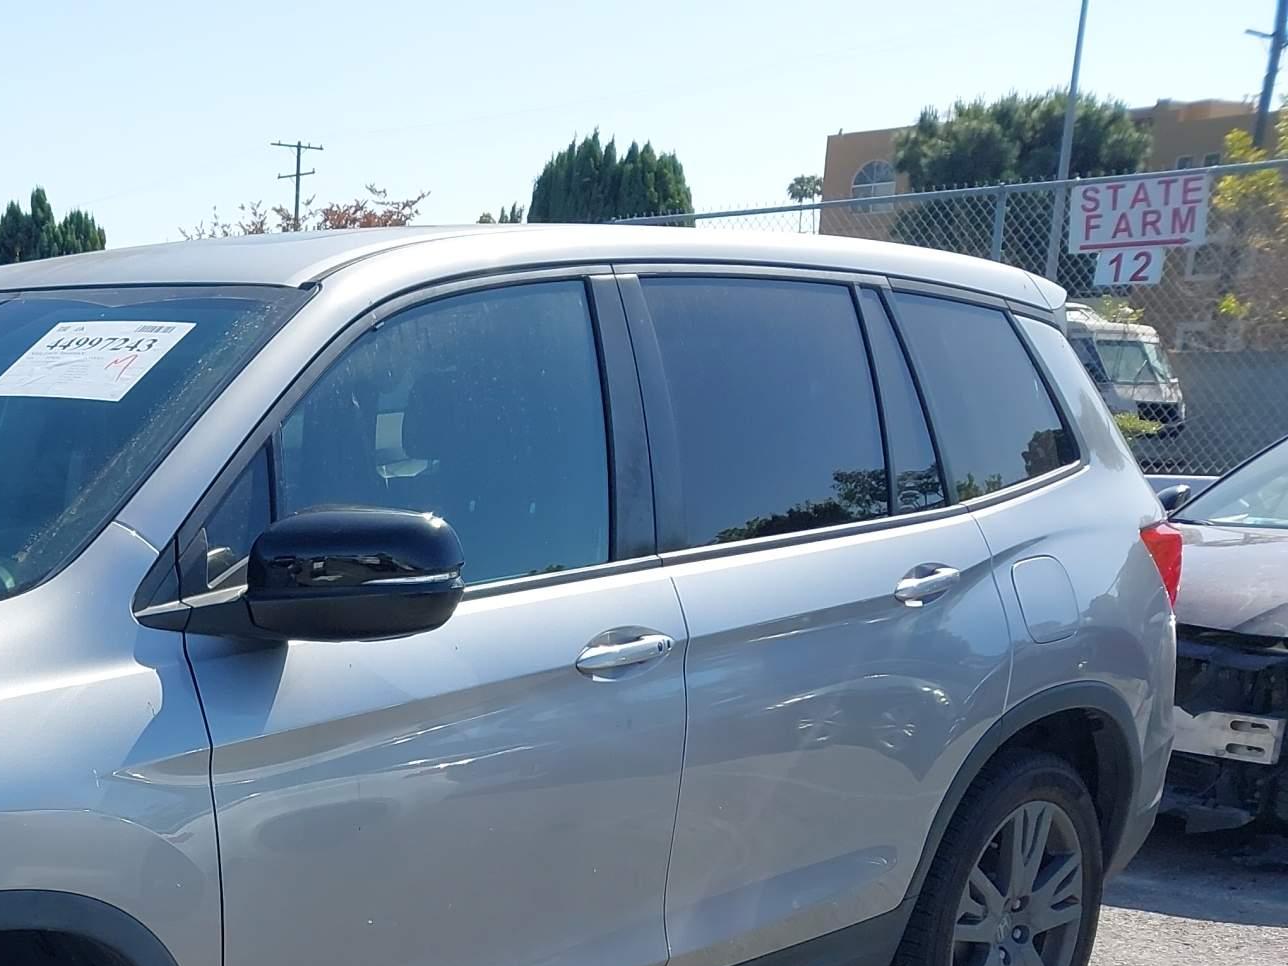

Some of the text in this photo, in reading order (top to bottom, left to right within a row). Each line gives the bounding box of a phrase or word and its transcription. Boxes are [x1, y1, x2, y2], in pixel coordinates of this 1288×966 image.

[1081, 176, 1204, 212] STATE
[1084, 205, 1197, 241] FARM
[1108, 250, 1153, 283] 12
[46, 337, 158, 352] 44997243
